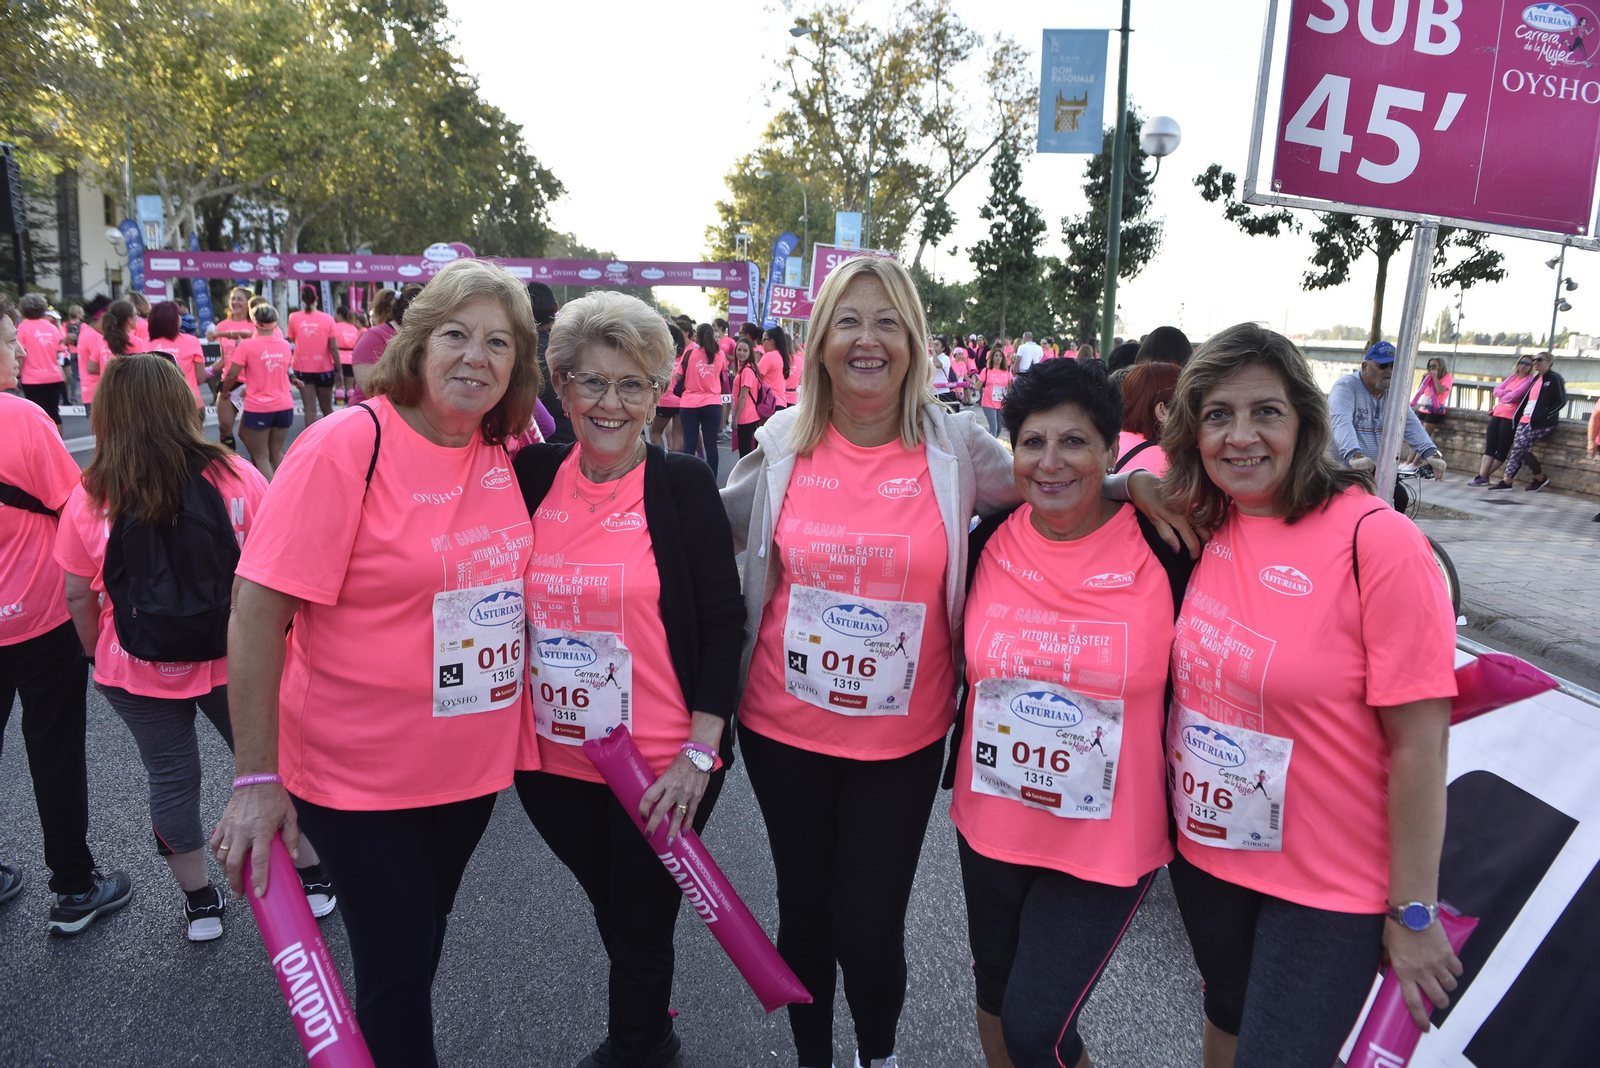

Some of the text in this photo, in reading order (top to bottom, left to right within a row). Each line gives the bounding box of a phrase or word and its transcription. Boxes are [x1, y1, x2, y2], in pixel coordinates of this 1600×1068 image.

[1526, 10, 1572, 27] ASTURIANA
[1515, 24, 1560, 44] Carrera
[1524, 41, 1574, 67] de la Mujer
[1052, 66, 1072, 74] DON
[1051, 74, 1095, 83] PASQUALE
[1502, 69, 1600, 104] OYSHO
[774, 287, 796, 299] SUB
[796, 474, 839, 490] OYSHO
[413, 485, 463, 505] OYSHO
[803, 522, 846, 538] GANAN
[472, 545, 501, 560] VITORIA
[506, 535, 532, 551] GASTEIZ
[811, 542, 846, 554] VITORIA
[856, 546, 894, 558] GASTEIZ
[489, 551, 520, 567] MADRID
[829, 554, 867, 566] MADRID
[531, 572, 563, 584] VITORIA
[572, 575, 608, 586] GASTEIZ
[811, 572, 821, 580] VA
[1262, 570, 1308, 593] ASTURIANA
[547, 584, 583, 595] MADRID
[533, 610, 547, 620] LEN
[826, 611, 883, 632] ASTURIANA
[985, 603, 1059, 626] HOY GANAN
[863, 638, 890, 650] Carrera
[1022, 629, 1059, 643] VITORIA
[1069, 634, 1110, 646] GASTEIZ
[1190, 616, 1255, 660] VITORIA GASTEIZ
[477, 639, 520, 669] 016
[1039, 642, 1080, 655] MADRID
[1180, 648, 1188, 660] VA
[1200, 635, 1230, 659] MADRID
[158, 663, 194, 673] ASTURIANA
[822, 650, 877, 677] 016
[1014, 655, 1024, 666] VA
[1179, 658, 1191, 672] LEN
[491, 667, 515, 683] 1316
[574, 668, 600, 679] Carrera
[1013, 665, 1030, 676] LEN
[1178, 669, 1190, 681] CIA
[790, 680, 818, 696] OYSHO
[832, 677, 861, 691] 1319
[1195, 673, 1213, 694] LAS
[441, 695, 478, 707] OYSHO
[541, 682, 590, 708] 016
[839, 697, 863, 705] Santander
[553, 708, 577, 721] 1318
[1015, 699, 1077, 723] ASTURIANA
[1201, 695, 1258, 731] CHICAS
[559, 727, 582, 735] Santander
[1055, 729, 1085, 742] Carrera
[1071, 741, 1093, 755] Mujer
[1184, 730, 1240, 764] ASTURIANA
[1012, 741, 1071, 773] 016
[1024, 771, 1053, 787] 1315
[1218, 767, 1248, 785] Carrera
[1182, 771, 1234, 810] 016
[1233, 781, 1257, 797] Mujer
[1031, 793, 1056, 803] Santander
[1075, 804, 1101, 812] ZURICH
[1190, 803, 1217, 821] 1312
[1195, 825, 1222, 835] Santander
[1242, 839, 1270, 848] ZURICH
[716, 891, 733, 912] TRIPLE
[272, 941, 340, 1061] Ladival
